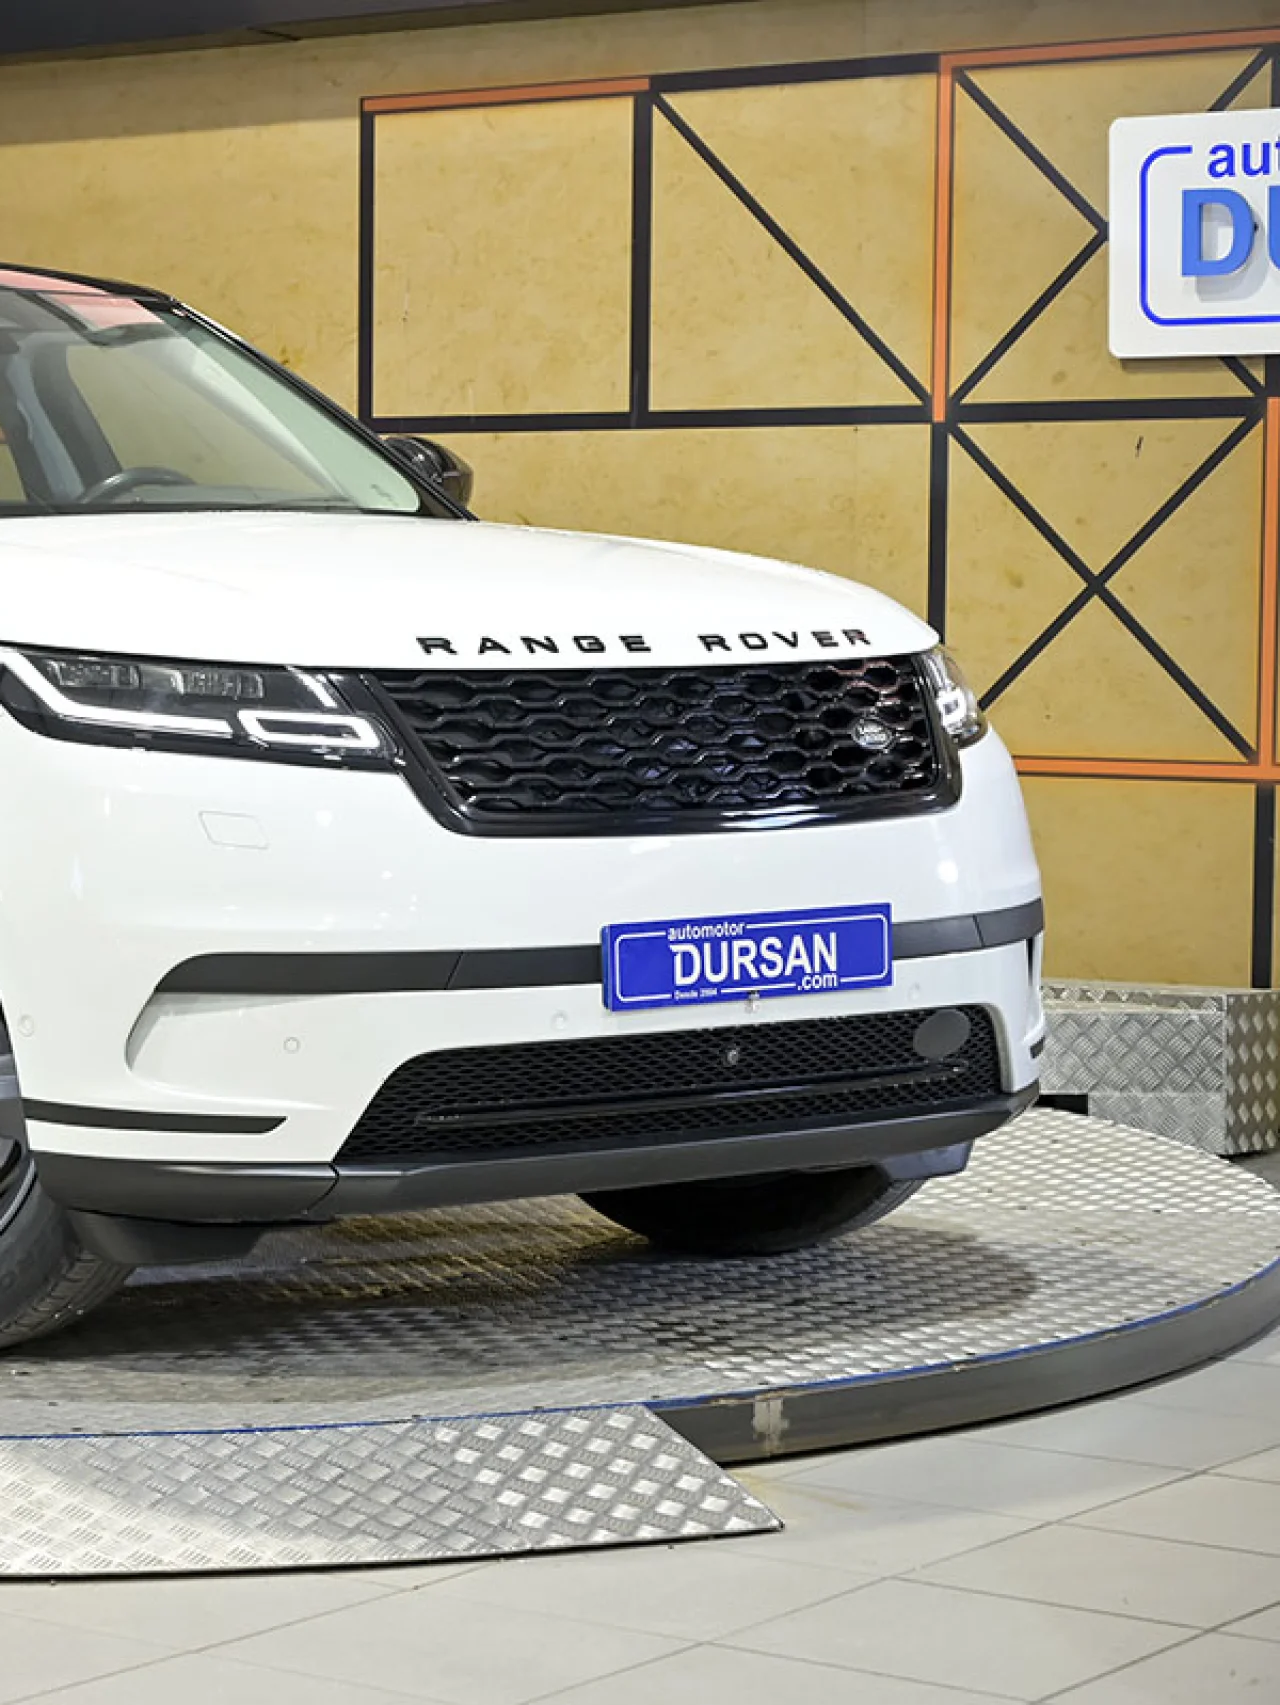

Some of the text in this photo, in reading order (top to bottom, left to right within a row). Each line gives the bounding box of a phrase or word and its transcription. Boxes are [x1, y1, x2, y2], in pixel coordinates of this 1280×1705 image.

[1181, 185, 1280, 277] D
[416, 628, 872, 656] RANGE ROVER
[667, 921, 746, 941] automotor
[669, 932, 838, 987] DURSAN
[797, 972, 838, 991] .com
